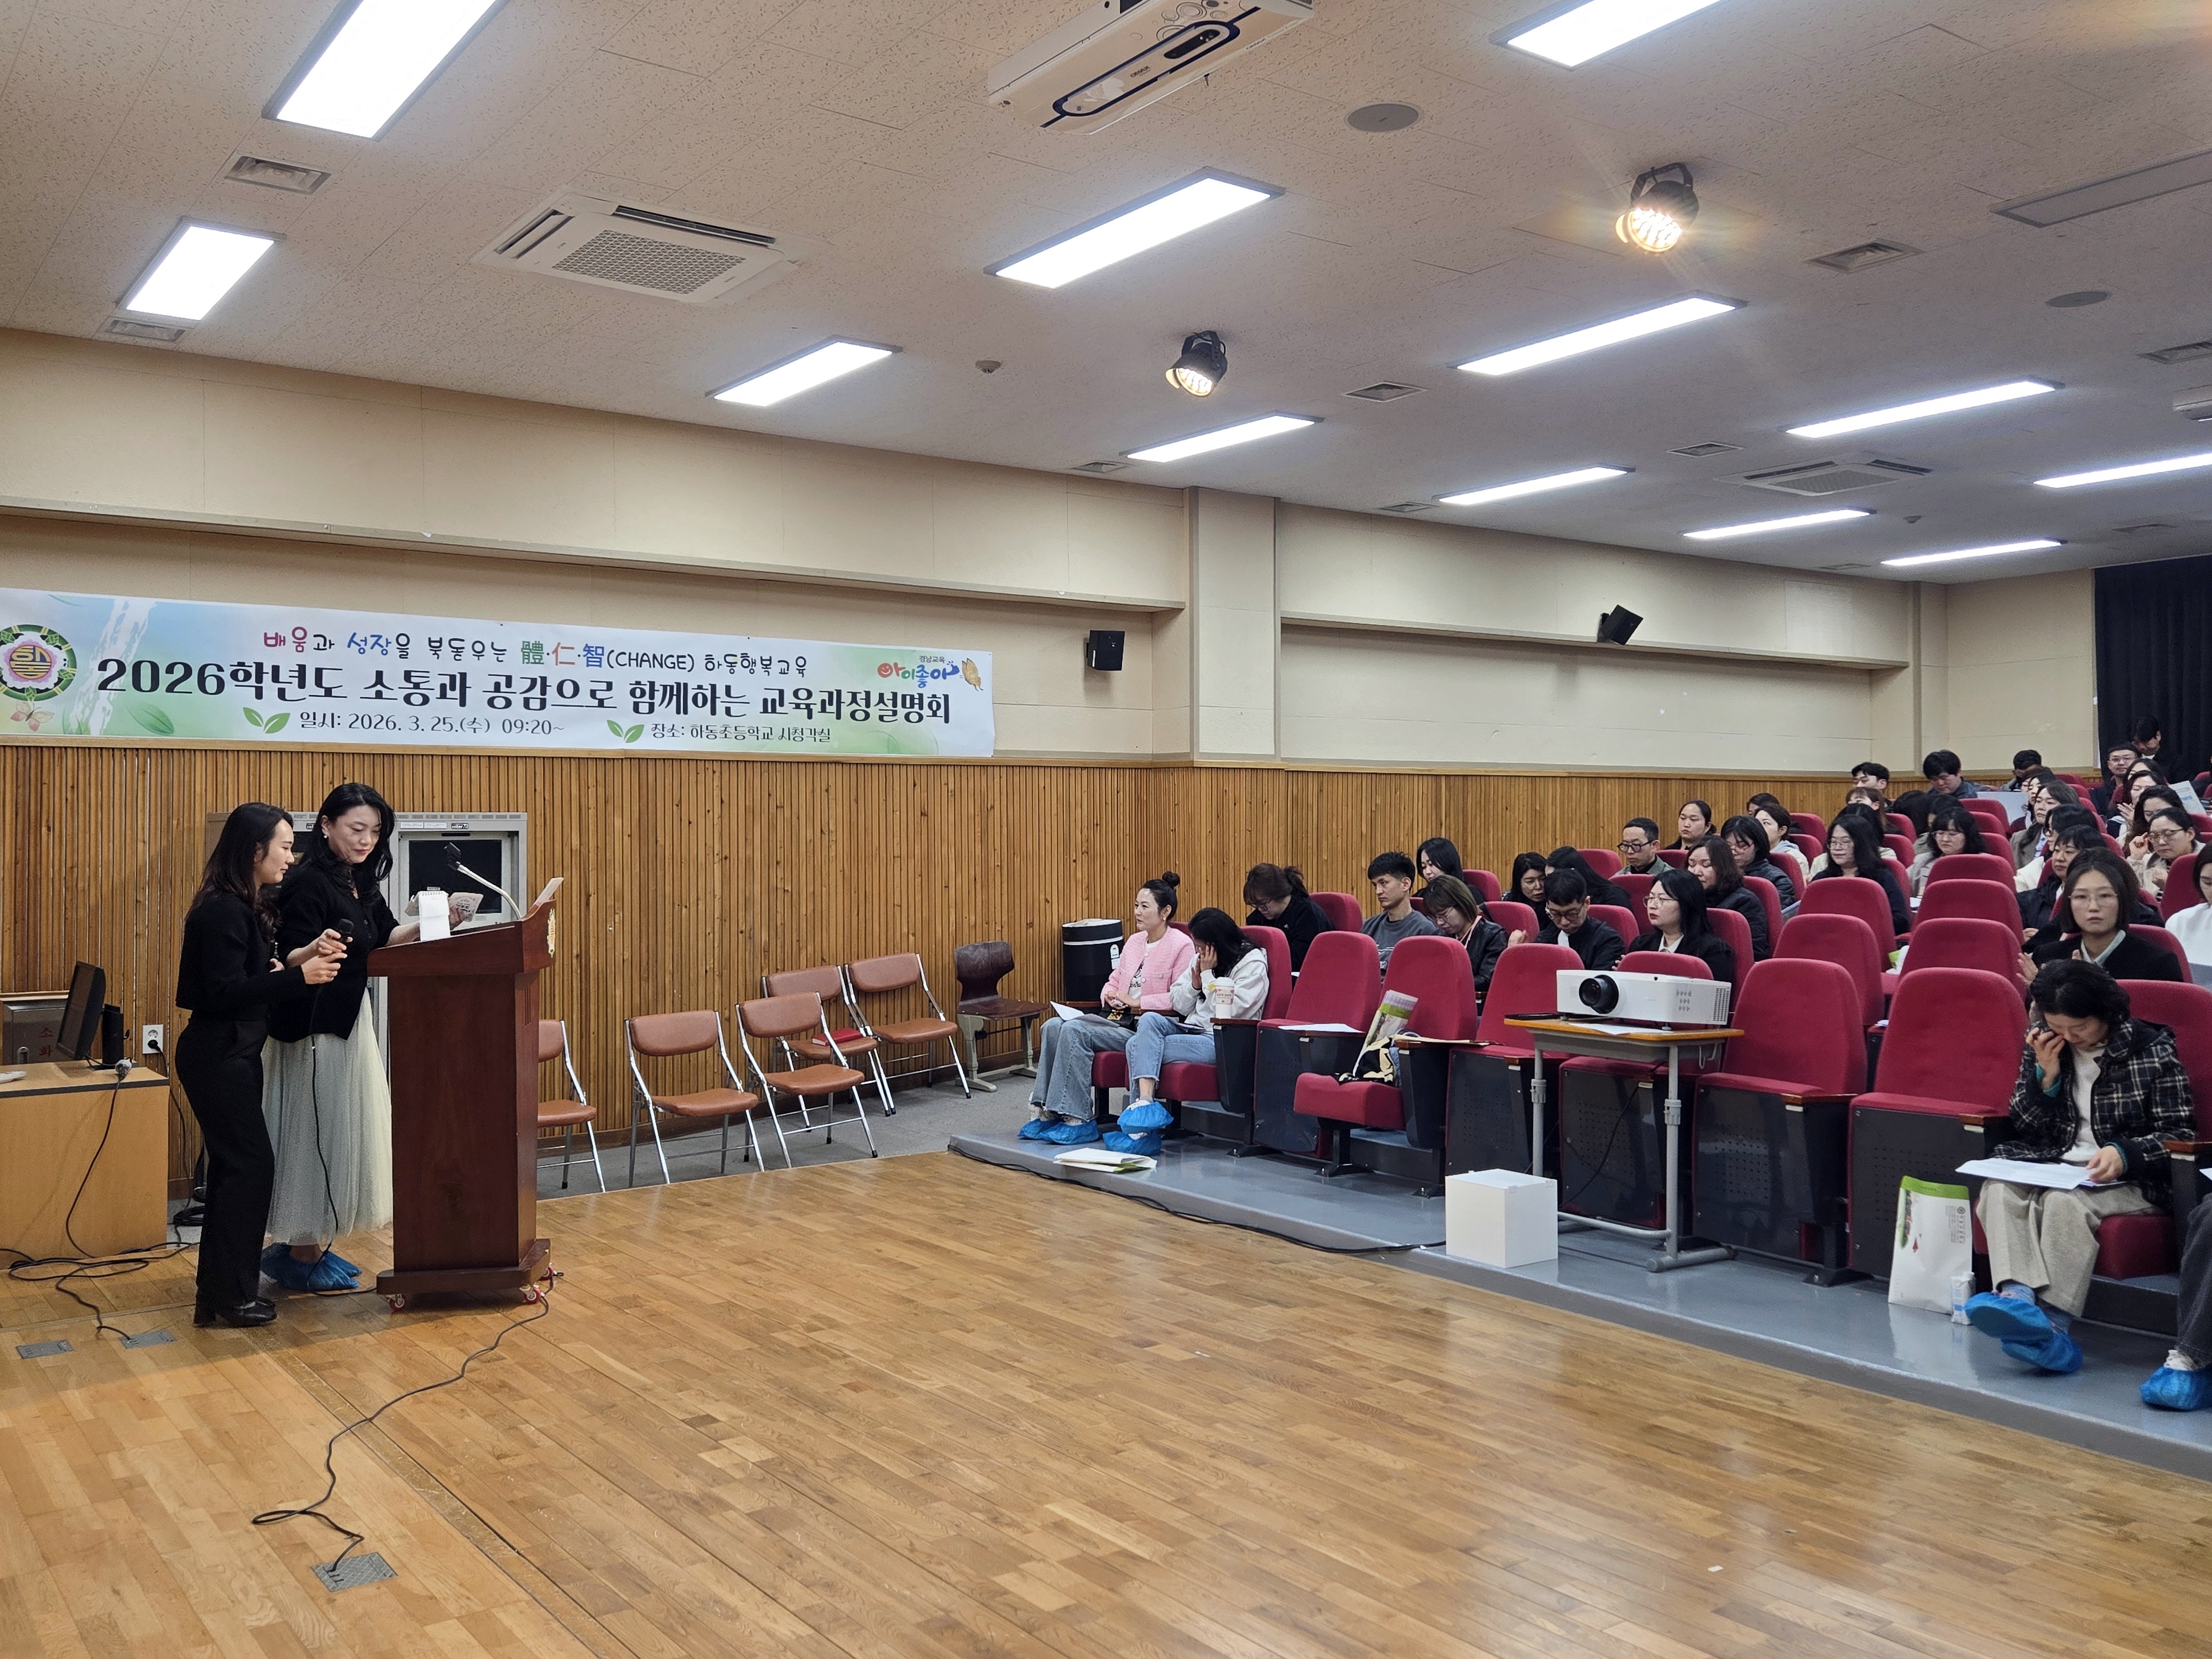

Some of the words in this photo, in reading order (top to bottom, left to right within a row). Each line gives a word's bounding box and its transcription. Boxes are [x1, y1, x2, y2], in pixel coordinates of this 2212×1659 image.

[263, 626, 335, 653] 배움과
[347, 632, 410, 659] 성장을
[428, 637, 507, 662] 북돋우는
[705, 653, 807, 677] 하동행복교육
[919, 655, 946, 664] 경남교육
[877, 661, 959, 688] 아이좋아
[98, 658, 347, 701] 2026학년도
[359, 670, 472, 707] 소통과
[482, 674, 617, 711] 공감으로
[629, 681, 750, 717] 함께하는
[759, 688, 950, 724] 교육과정설명회
[300, 712, 341, 729] 일시:
[348, 713, 401, 730] 2026.
[408, 716, 424, 731] 3.
[431, 716, 490, 733] 25.(수)
[502, 719, 565, 734] 09:20~
[651, 723, 685, 738] 장소:
[690, 724, 774, 740] 하동초등학교
[778, 727, 830, 742] 시청각실
